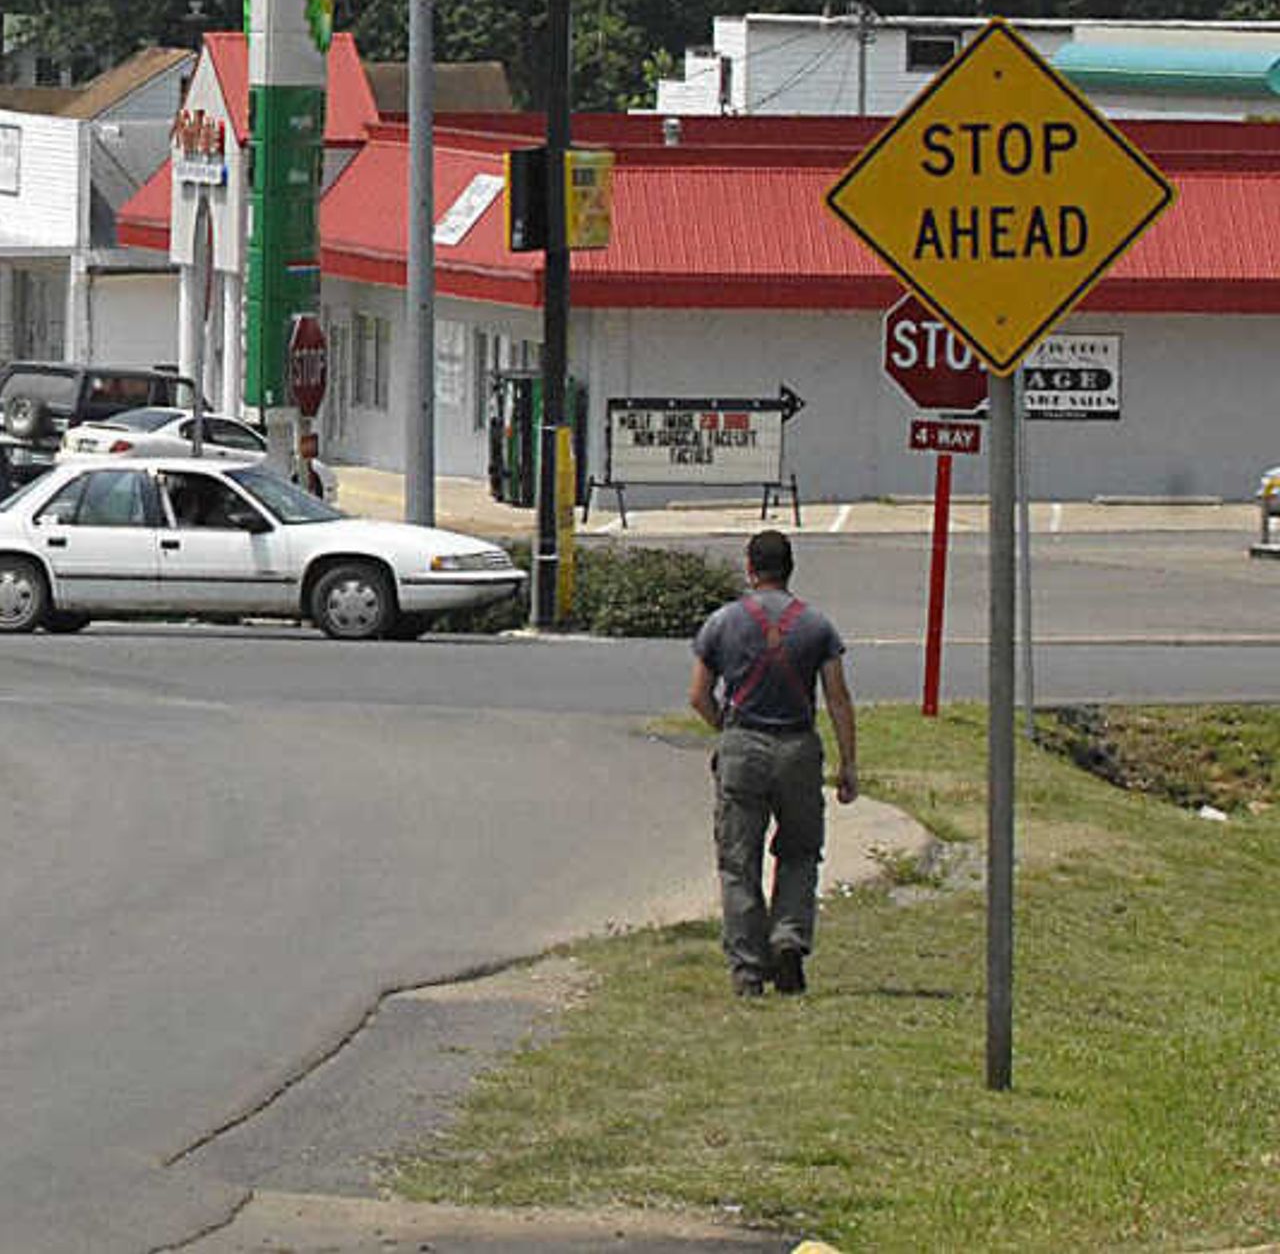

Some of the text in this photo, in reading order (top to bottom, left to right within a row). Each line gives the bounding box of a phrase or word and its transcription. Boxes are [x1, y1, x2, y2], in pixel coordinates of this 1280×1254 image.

[920, 122, 1078, 177] STOP
[913, 205, 1089, 260] AHEAD
[891, 319, 988, 372] STO
